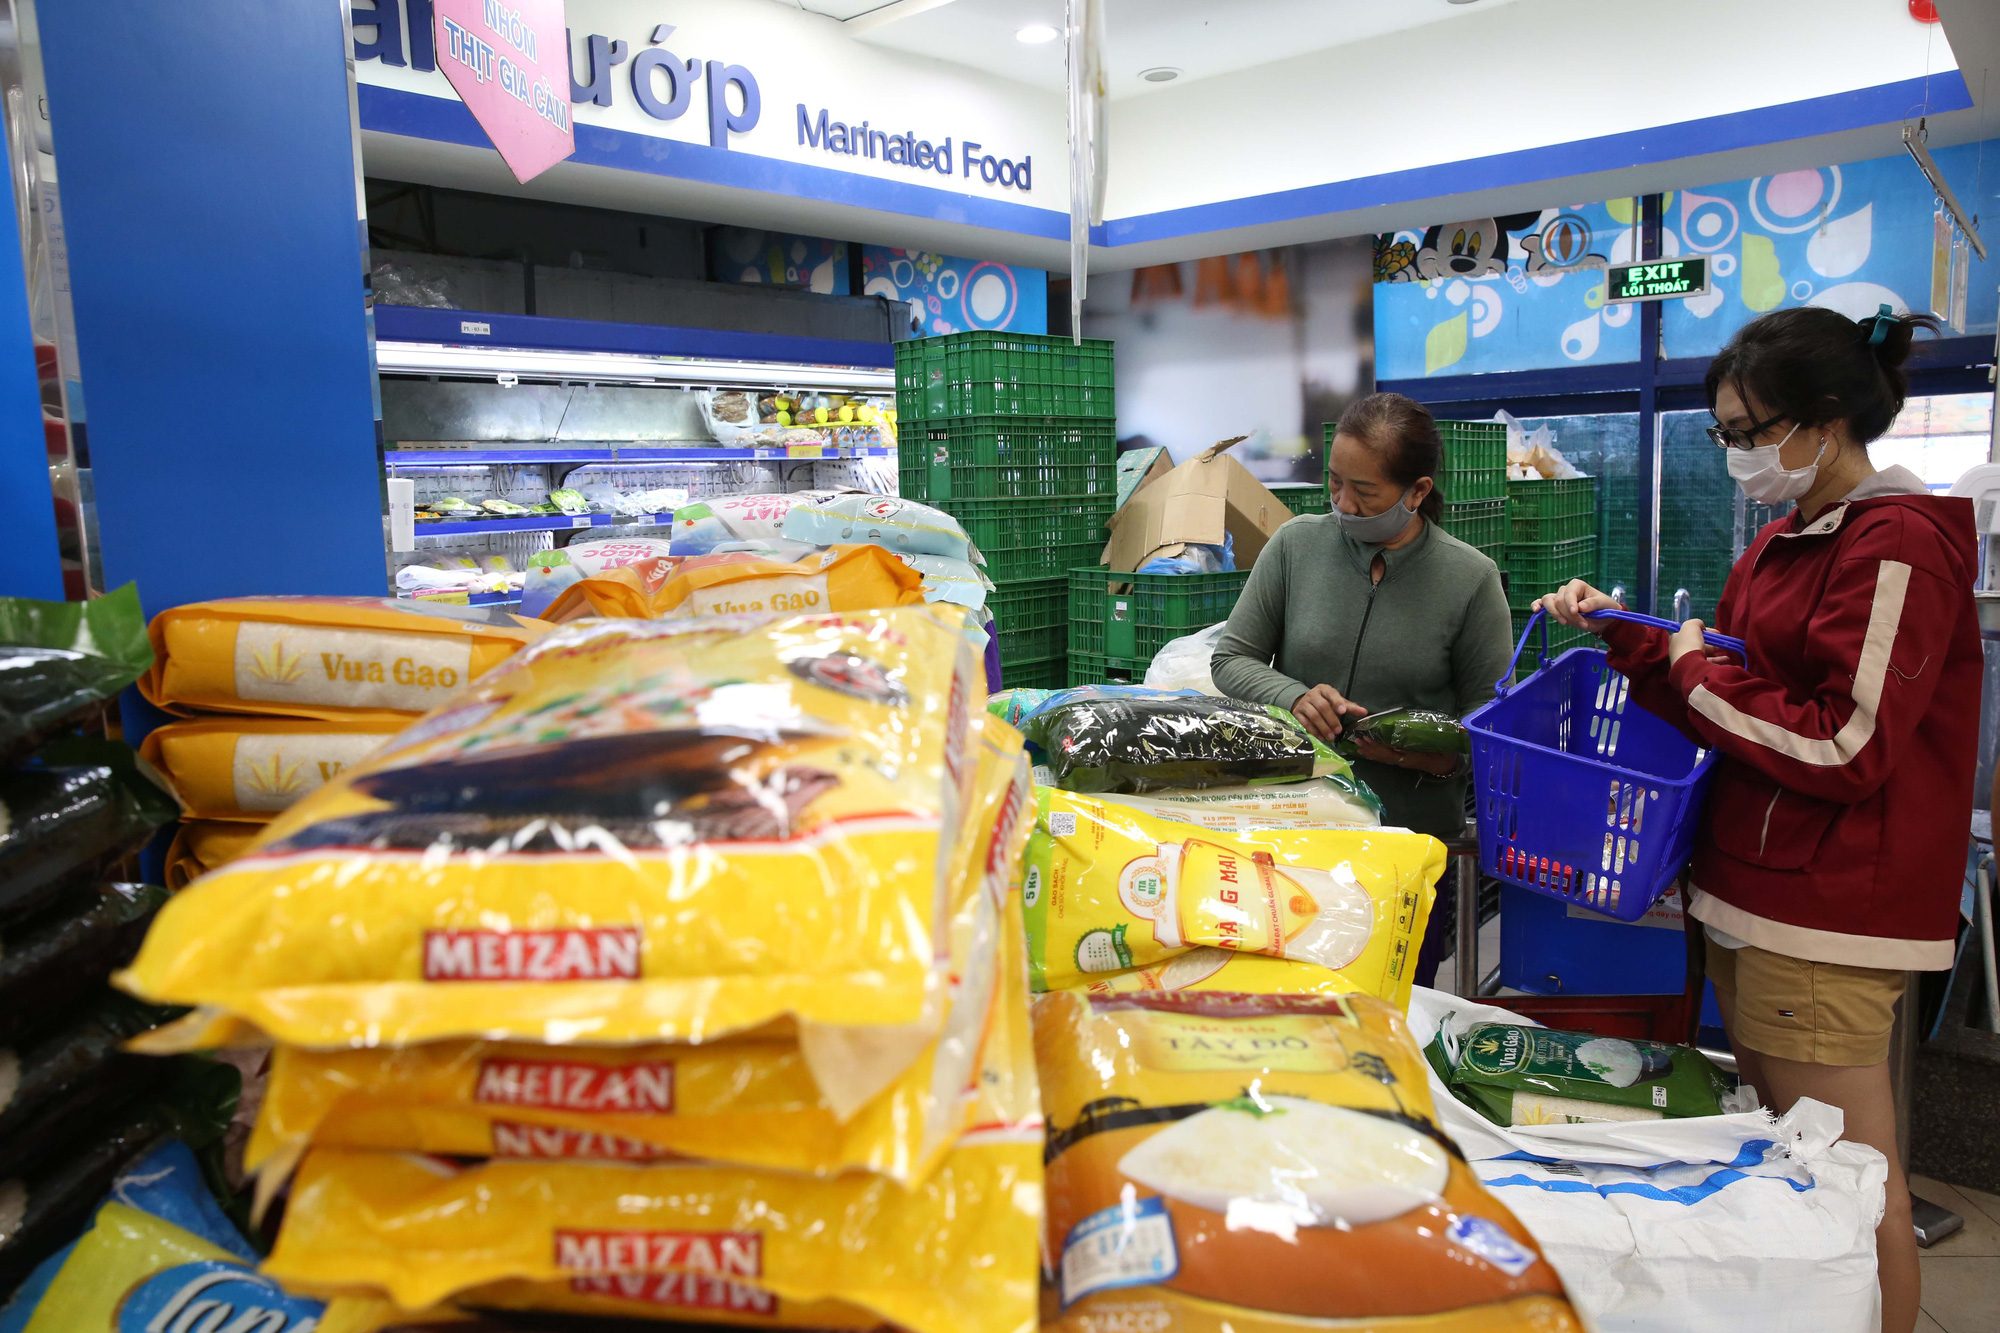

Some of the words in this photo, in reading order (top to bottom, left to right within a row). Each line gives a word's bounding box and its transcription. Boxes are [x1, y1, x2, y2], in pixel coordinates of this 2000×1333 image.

[483, 0, 538, 65] NHÓM
[443, 15, 495, 84] THỊT
[498, 56, 533, 109] GIA
[533, 74, 569, 134] CẦM
[797, 103, 953, 175] Marinated
[962, 141, 1032, 191] Food
[1621, 280, 1645, 298] LỐI
[1647, 278, 1690, 295] THOÁT
[1628, 262, 1684, 282] EXIT
[320, 652, 385, 683] Vua
[392, 657, 458, 690] Gạo
[1138, 880, 1148, 892] ITA
[1217, 854, 1239, 884] MAI
[1025, 890, 1036, 900] 5
[1148, 878, 1157, 896] RICE
[1214, 889, 1239, 949] NÀG
[427, 931, 640, 978] MEIZAN
[1502, 1030, 1521, 1047] Gạo
[1499, 1047, 1518, 1066] Vua
[478, 1060, 673, 1107] MEIZAN
[558, 1232, 760, 1276] MEIZAN
